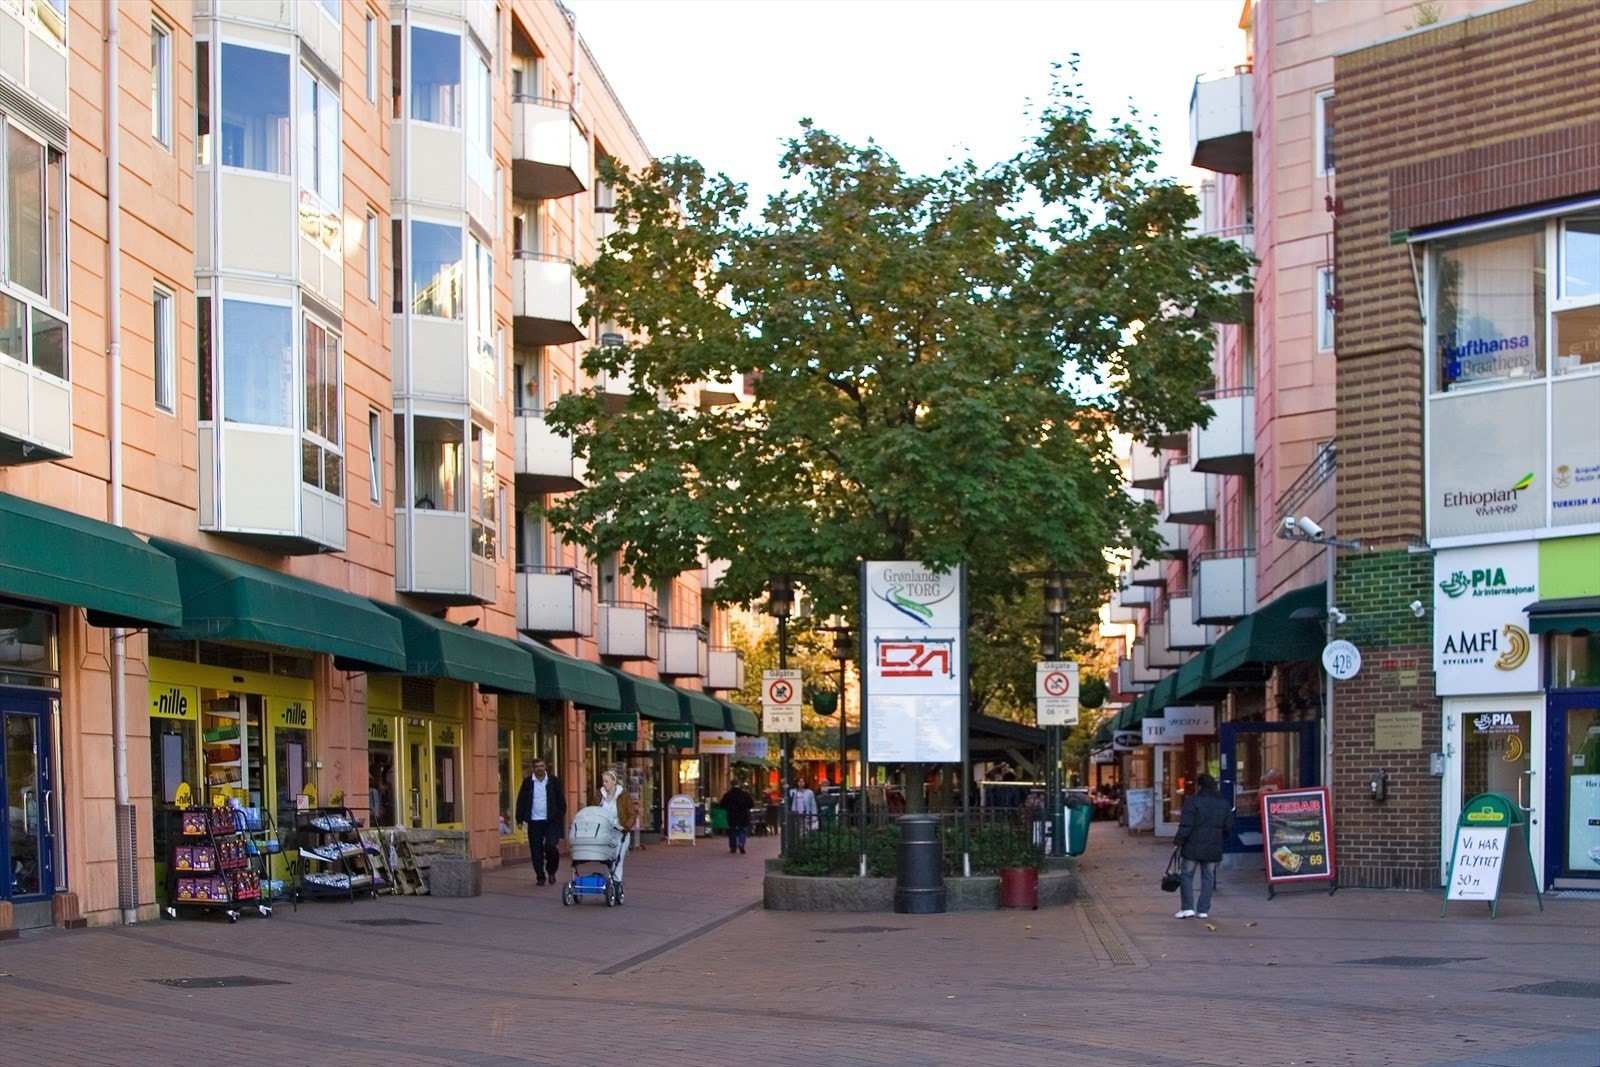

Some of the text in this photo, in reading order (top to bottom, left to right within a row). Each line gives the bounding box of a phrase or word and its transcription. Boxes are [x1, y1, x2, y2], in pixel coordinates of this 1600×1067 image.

[1447, 335, 1529, 359] Lufthansa
[1463, 354, 1530, 376] Braathens
[1443, 489, 1518, 507] Ethiopian
[1552, 498, 1588, 508] TURKISH
[883, 567, 941, 584] Grønlands
[1471, 567, 1507, 588] PIA
[906, 583, 941, 597] TORG
[1472, 589, 1484, 597] Air
[1442, 628, 1498, 655] AMFI
[1332, 654, 1352, 675] 42B
[1492, 713, 1514, 725] PIA
[594, 722, 635, 734] NOTABENE
[656, 731, 691, 743] NOTABENE
[1270, 800, 1321, 813] KEBAB
[1308, 831, 1321, 842] 45
[1478, 838, 1499, 851] HAR
[1310, 854, 1323, 866] 69
[1460, 854, 1500, 868] FLYTTET
[1457, 874, 1472, 886] 30
